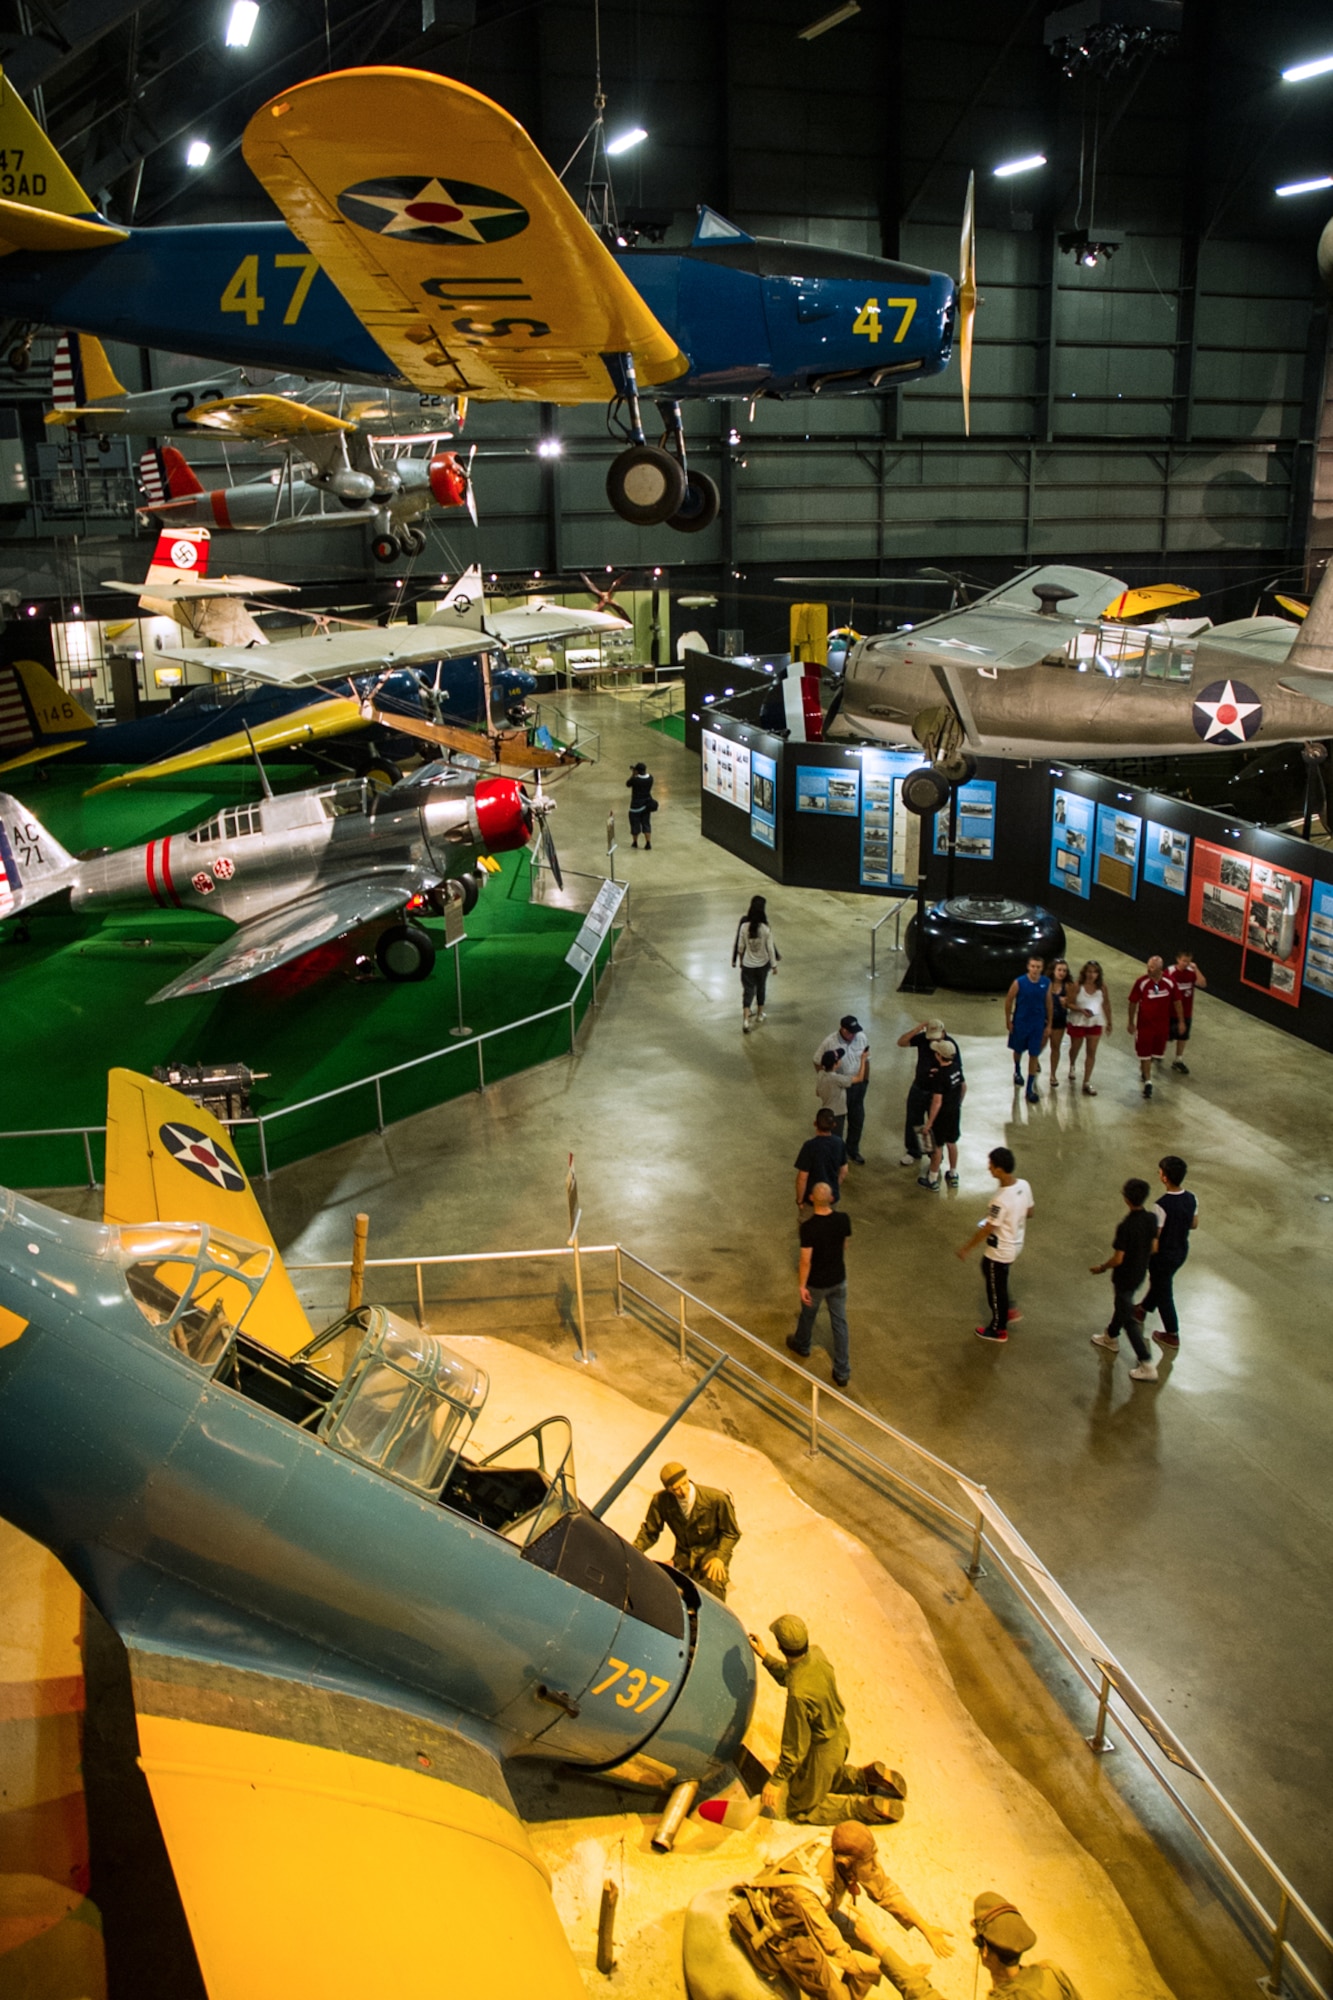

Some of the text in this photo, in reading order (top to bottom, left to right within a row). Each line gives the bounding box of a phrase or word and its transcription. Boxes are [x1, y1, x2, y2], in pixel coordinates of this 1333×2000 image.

[219, 254, 321, 325] 47
[852, 297, 918, 343] 47
[42, 702, 74, 724] 146
[14, 823, 40, 846] AC
[20, 845, 45, 867] 71
[591, 1656, 671, 1714] 737
